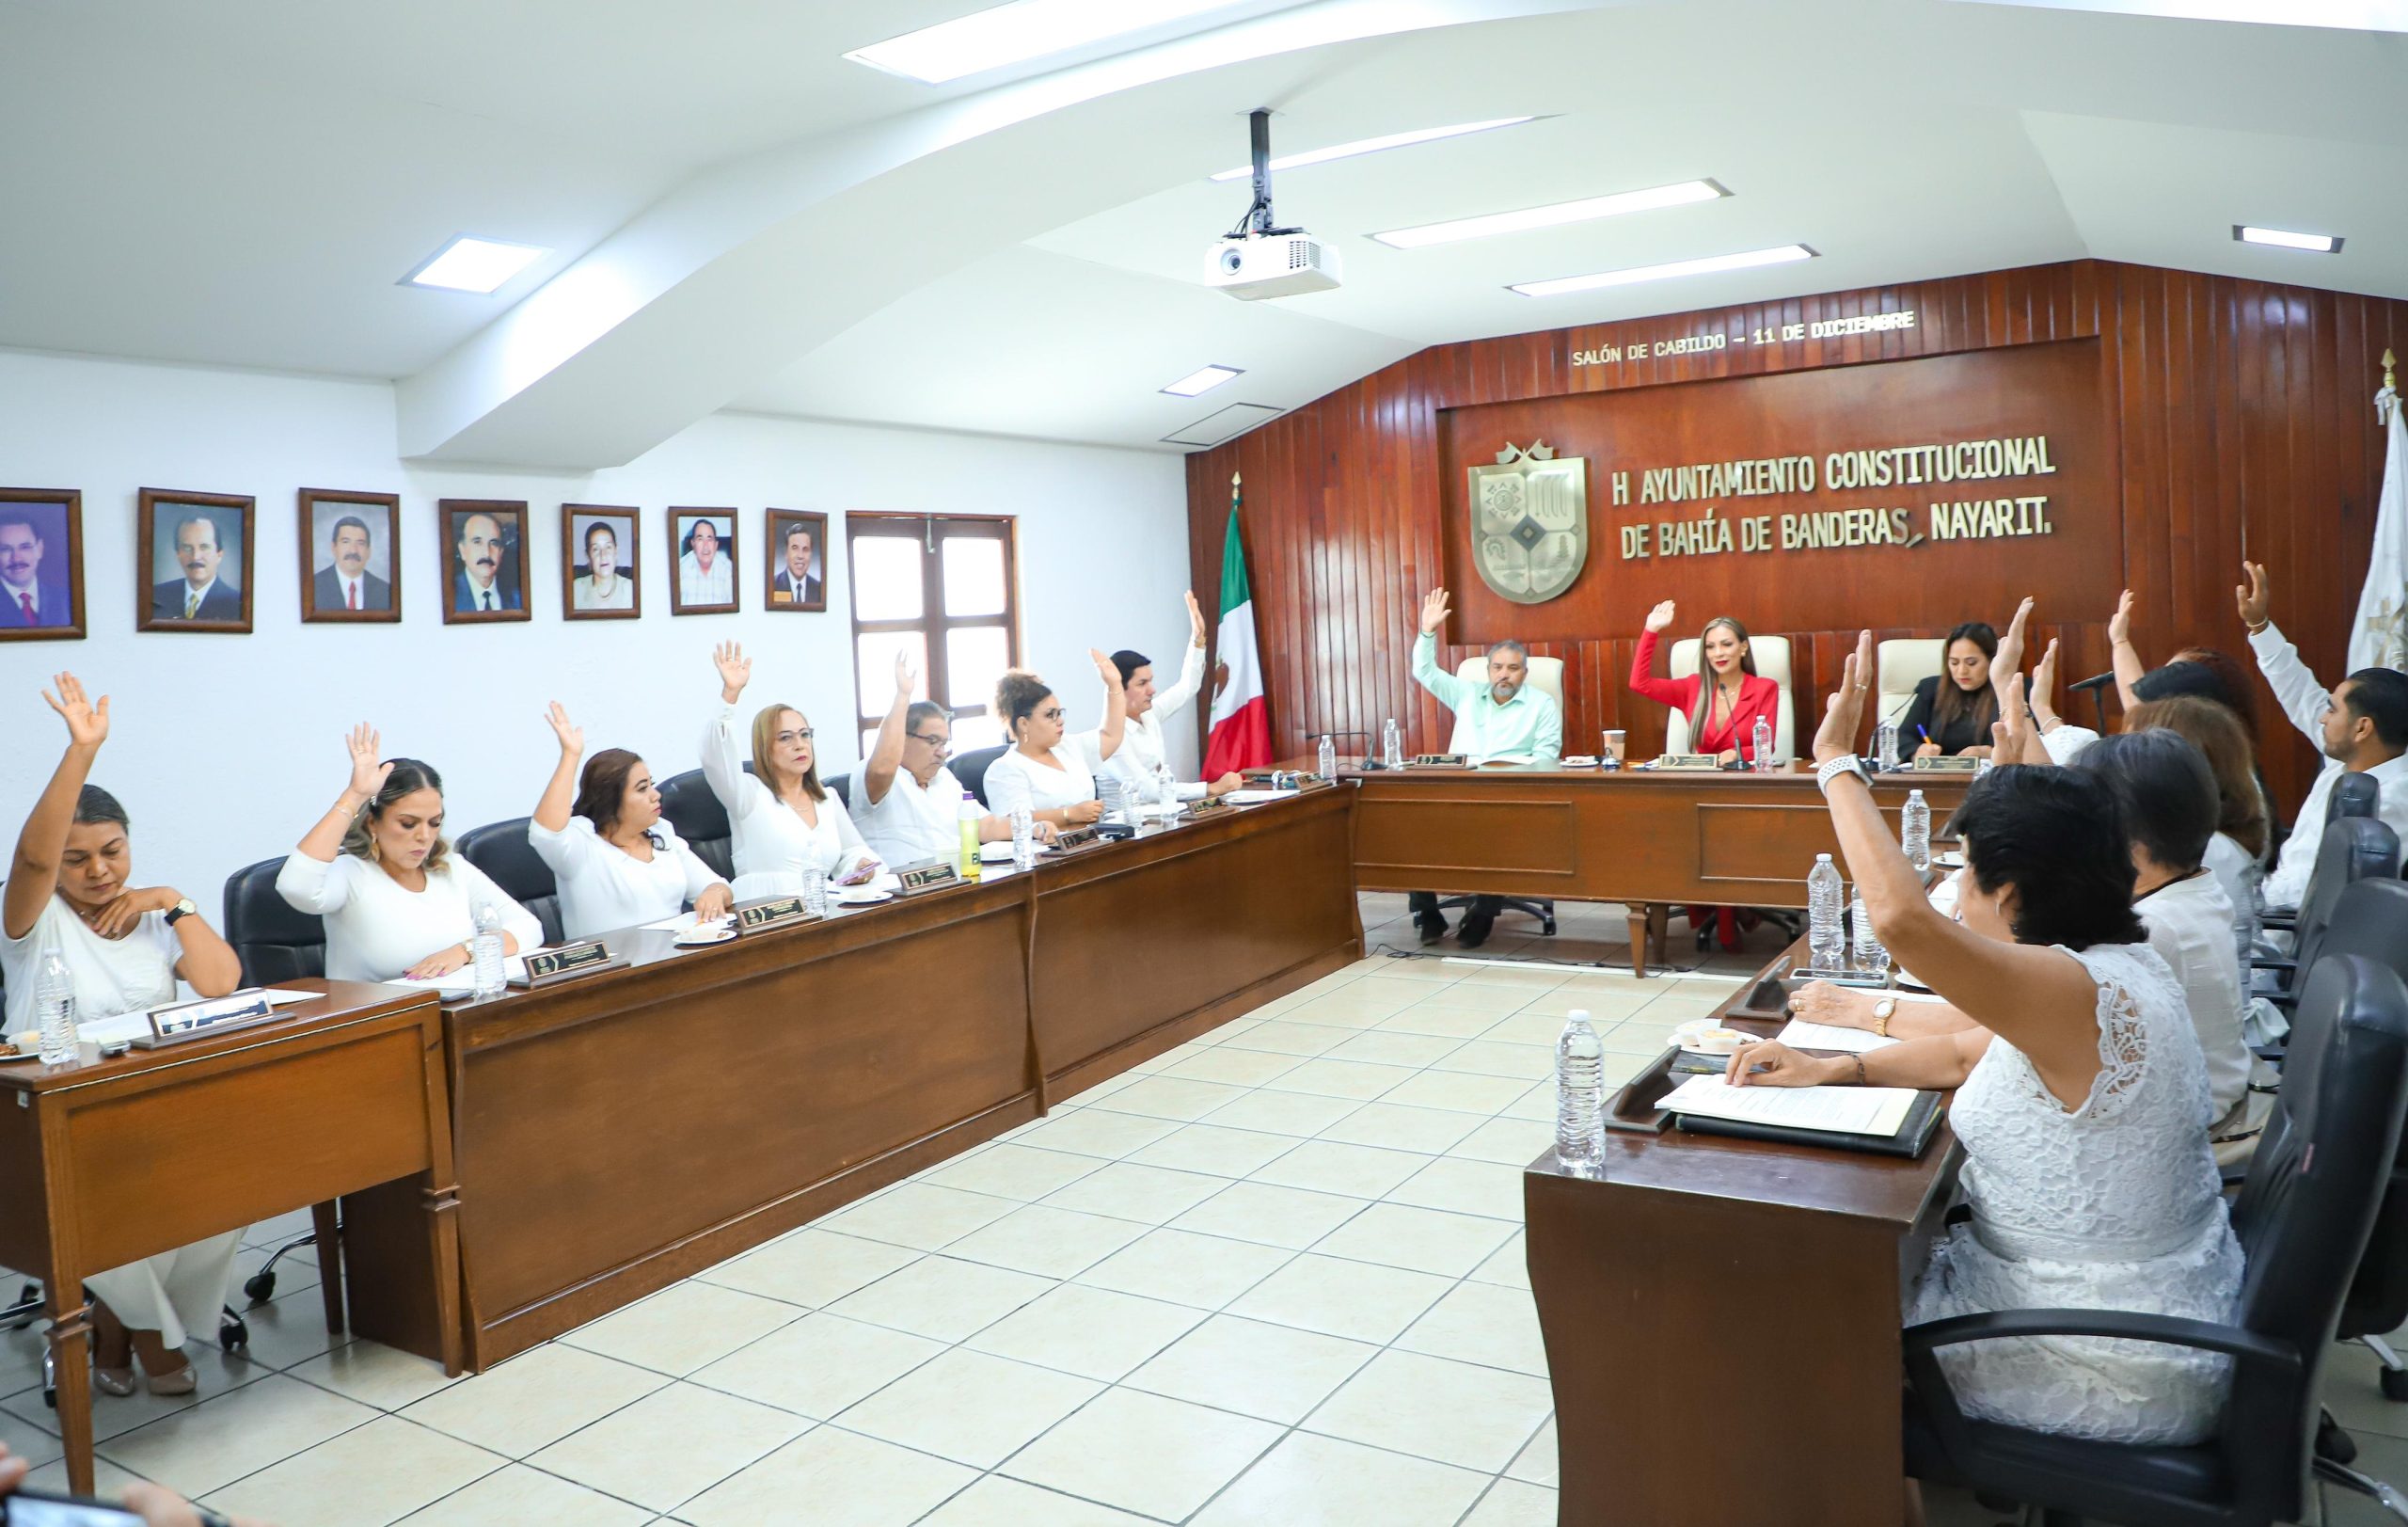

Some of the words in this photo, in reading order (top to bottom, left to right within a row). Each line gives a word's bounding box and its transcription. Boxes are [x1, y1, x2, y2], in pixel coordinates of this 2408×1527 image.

[1572, 345, 1621, 366] SALÓN
[1627, 343, 1648, 360] DE
[1654, 333, 1726, 357] CABILDO
[1752, 327, 1776, 345] 11
[1782, 324, 1805, 342] DE
[1811, 310, 1914, 340] DICIEMBRE
[1611, 471, 1628, 505] H
[1640, 455, 1815, 504] AYUNTAMIENTO
[1825, 436, 2055, 491] CONSTITUCIONAL
[1621, 524, 1650, 560] DE
[1658, 507, 1734, 557] BAHÍA
[1741, 515, 1771, 553] DE
[1782, 508, 1925, 549] BANDERAS,
[1930, 495, 2052, 541] NAYARIT.
